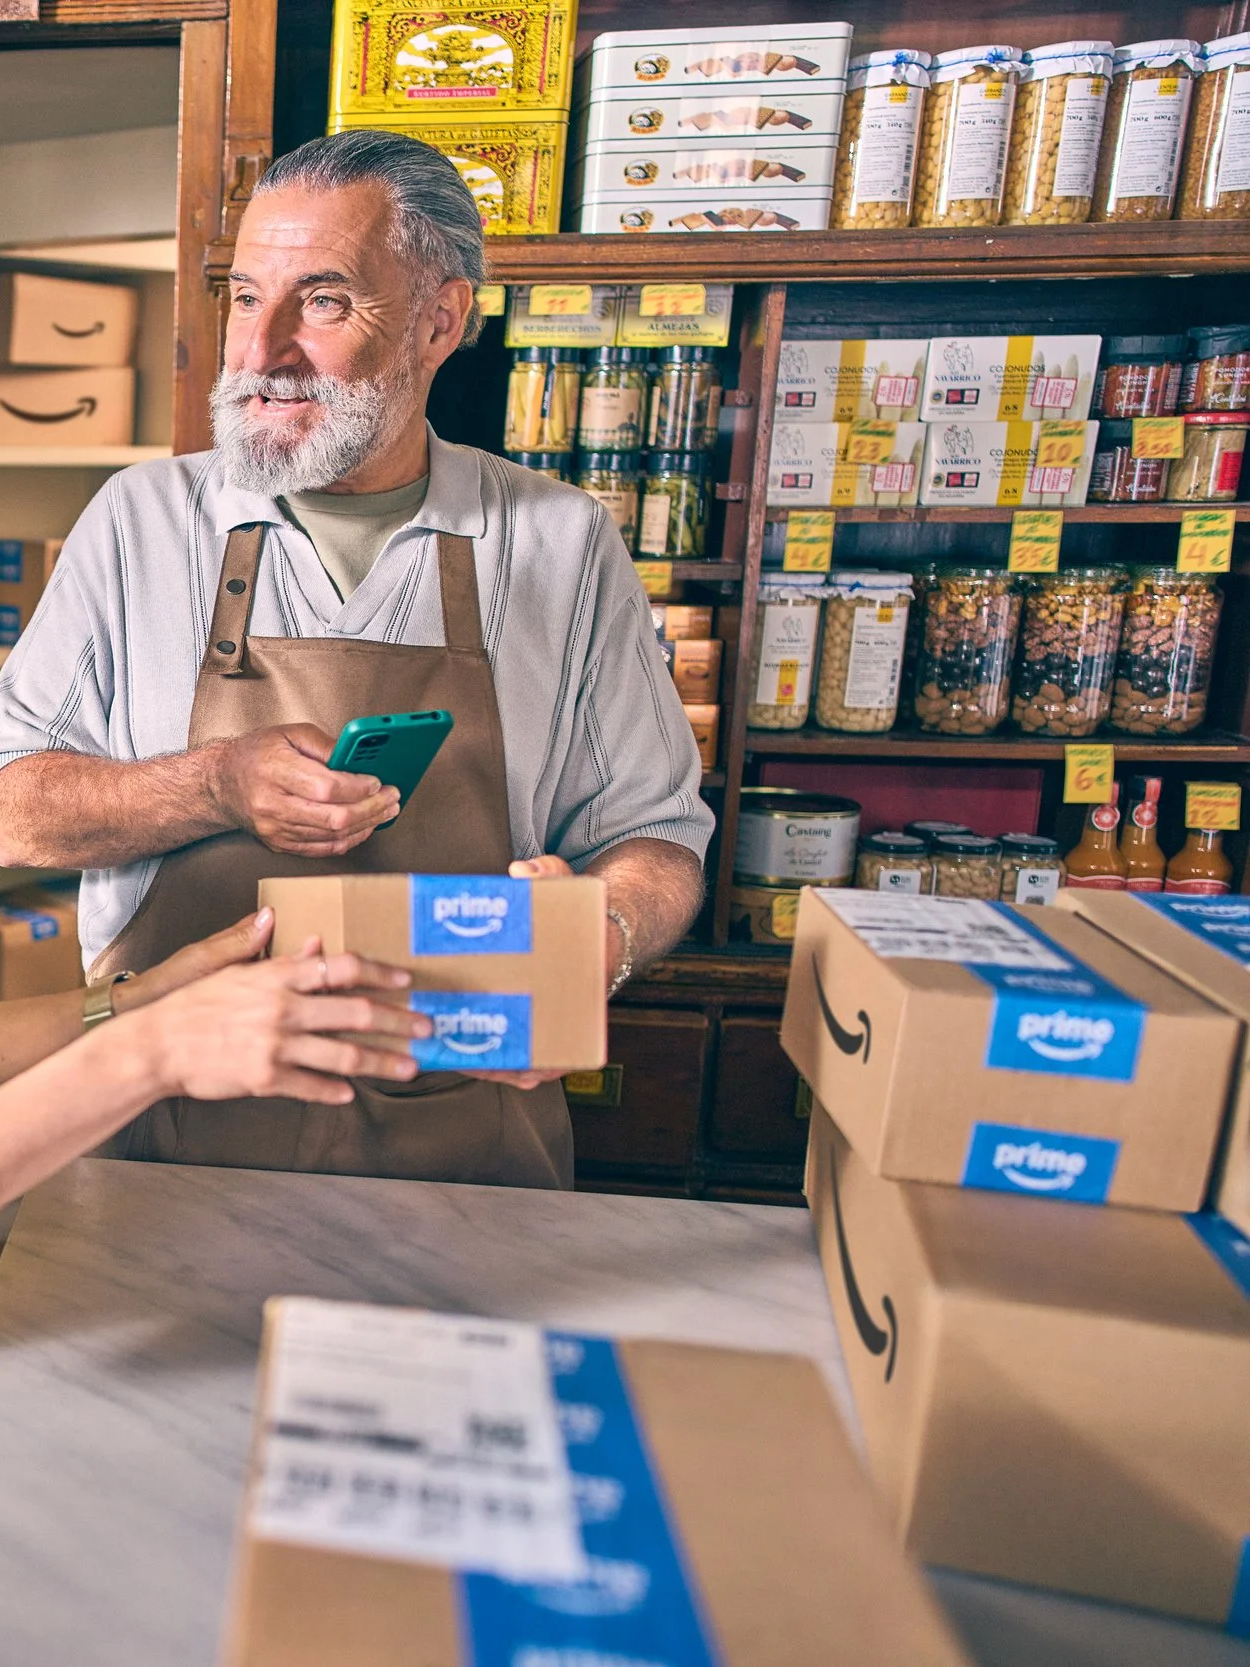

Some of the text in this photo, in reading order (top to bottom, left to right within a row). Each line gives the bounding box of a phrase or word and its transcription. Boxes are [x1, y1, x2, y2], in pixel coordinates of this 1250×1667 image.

[989, 364, 1046, 373] COJONUDOS
[777, 377, 816, 385] AVARRICO
[853, 440, 883, 460] 23
[1043, 442, 1073, 464] 10
[785, 823, 832, 840] Castaing
[433, 893, 509, 923] prime
[434, 1010, 509, 1038] prime
[1017, 1010, 1115, 1042] prime
[993, 1142, 1087, 1171] prime
